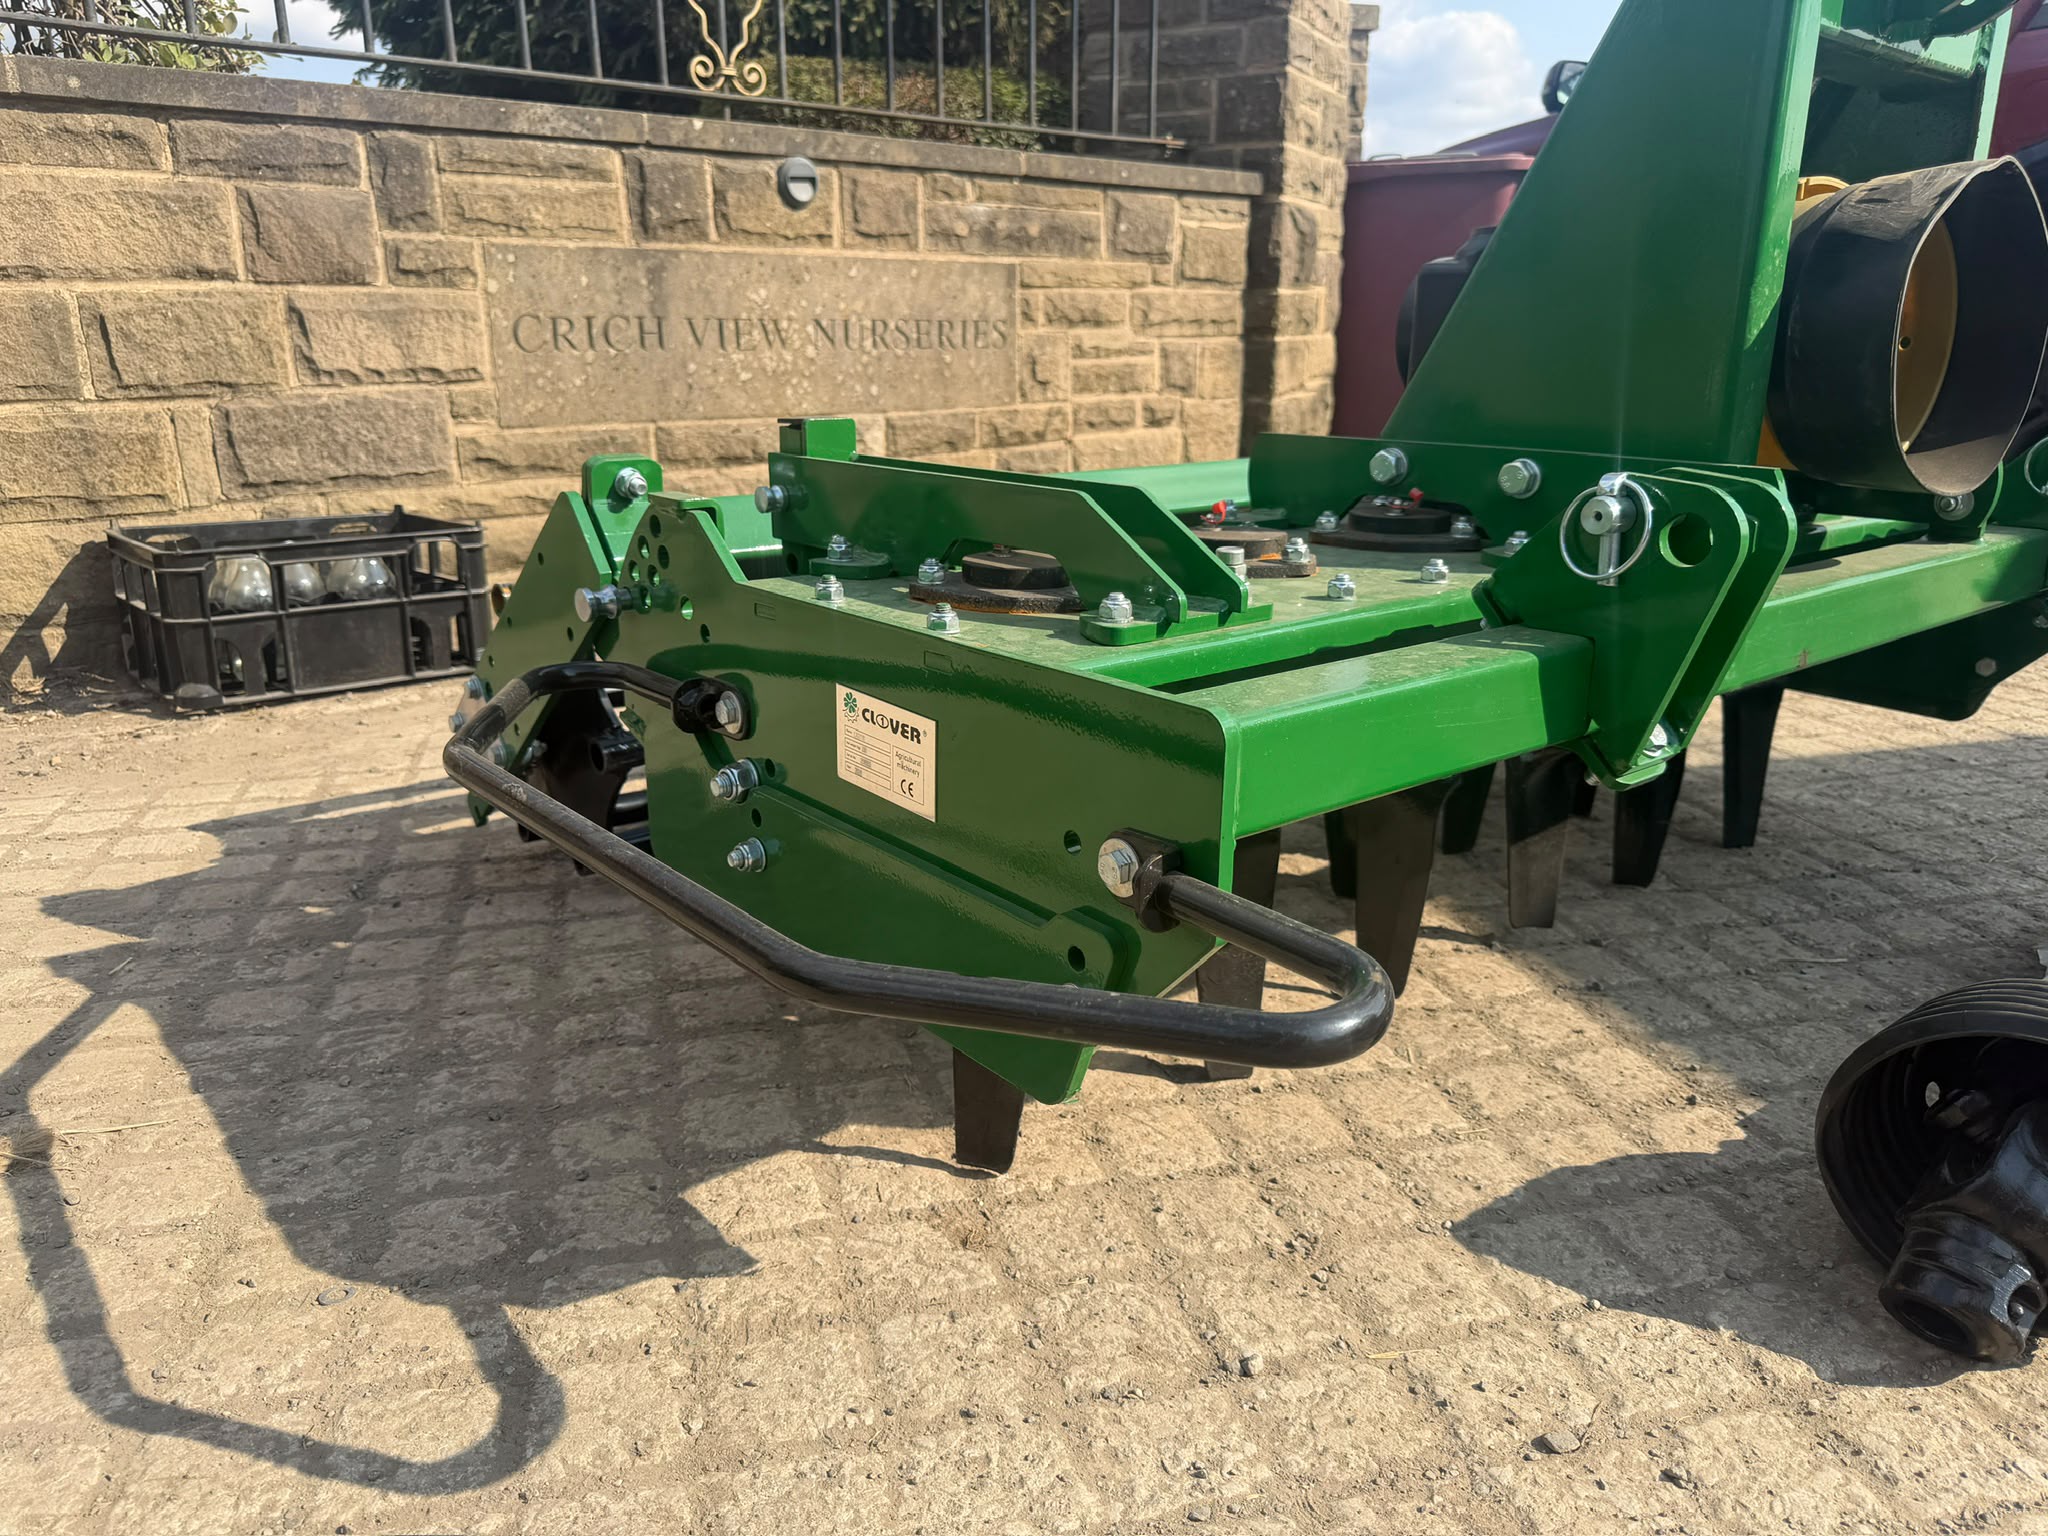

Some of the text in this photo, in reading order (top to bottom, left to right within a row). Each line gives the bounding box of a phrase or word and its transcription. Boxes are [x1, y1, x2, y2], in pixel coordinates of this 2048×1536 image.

[512, 313, 1010, 354] CRICH VIEW NURSERIES
[895, 751, 922, 768] Agricultural
[896, 761, 920, 778] machinery
